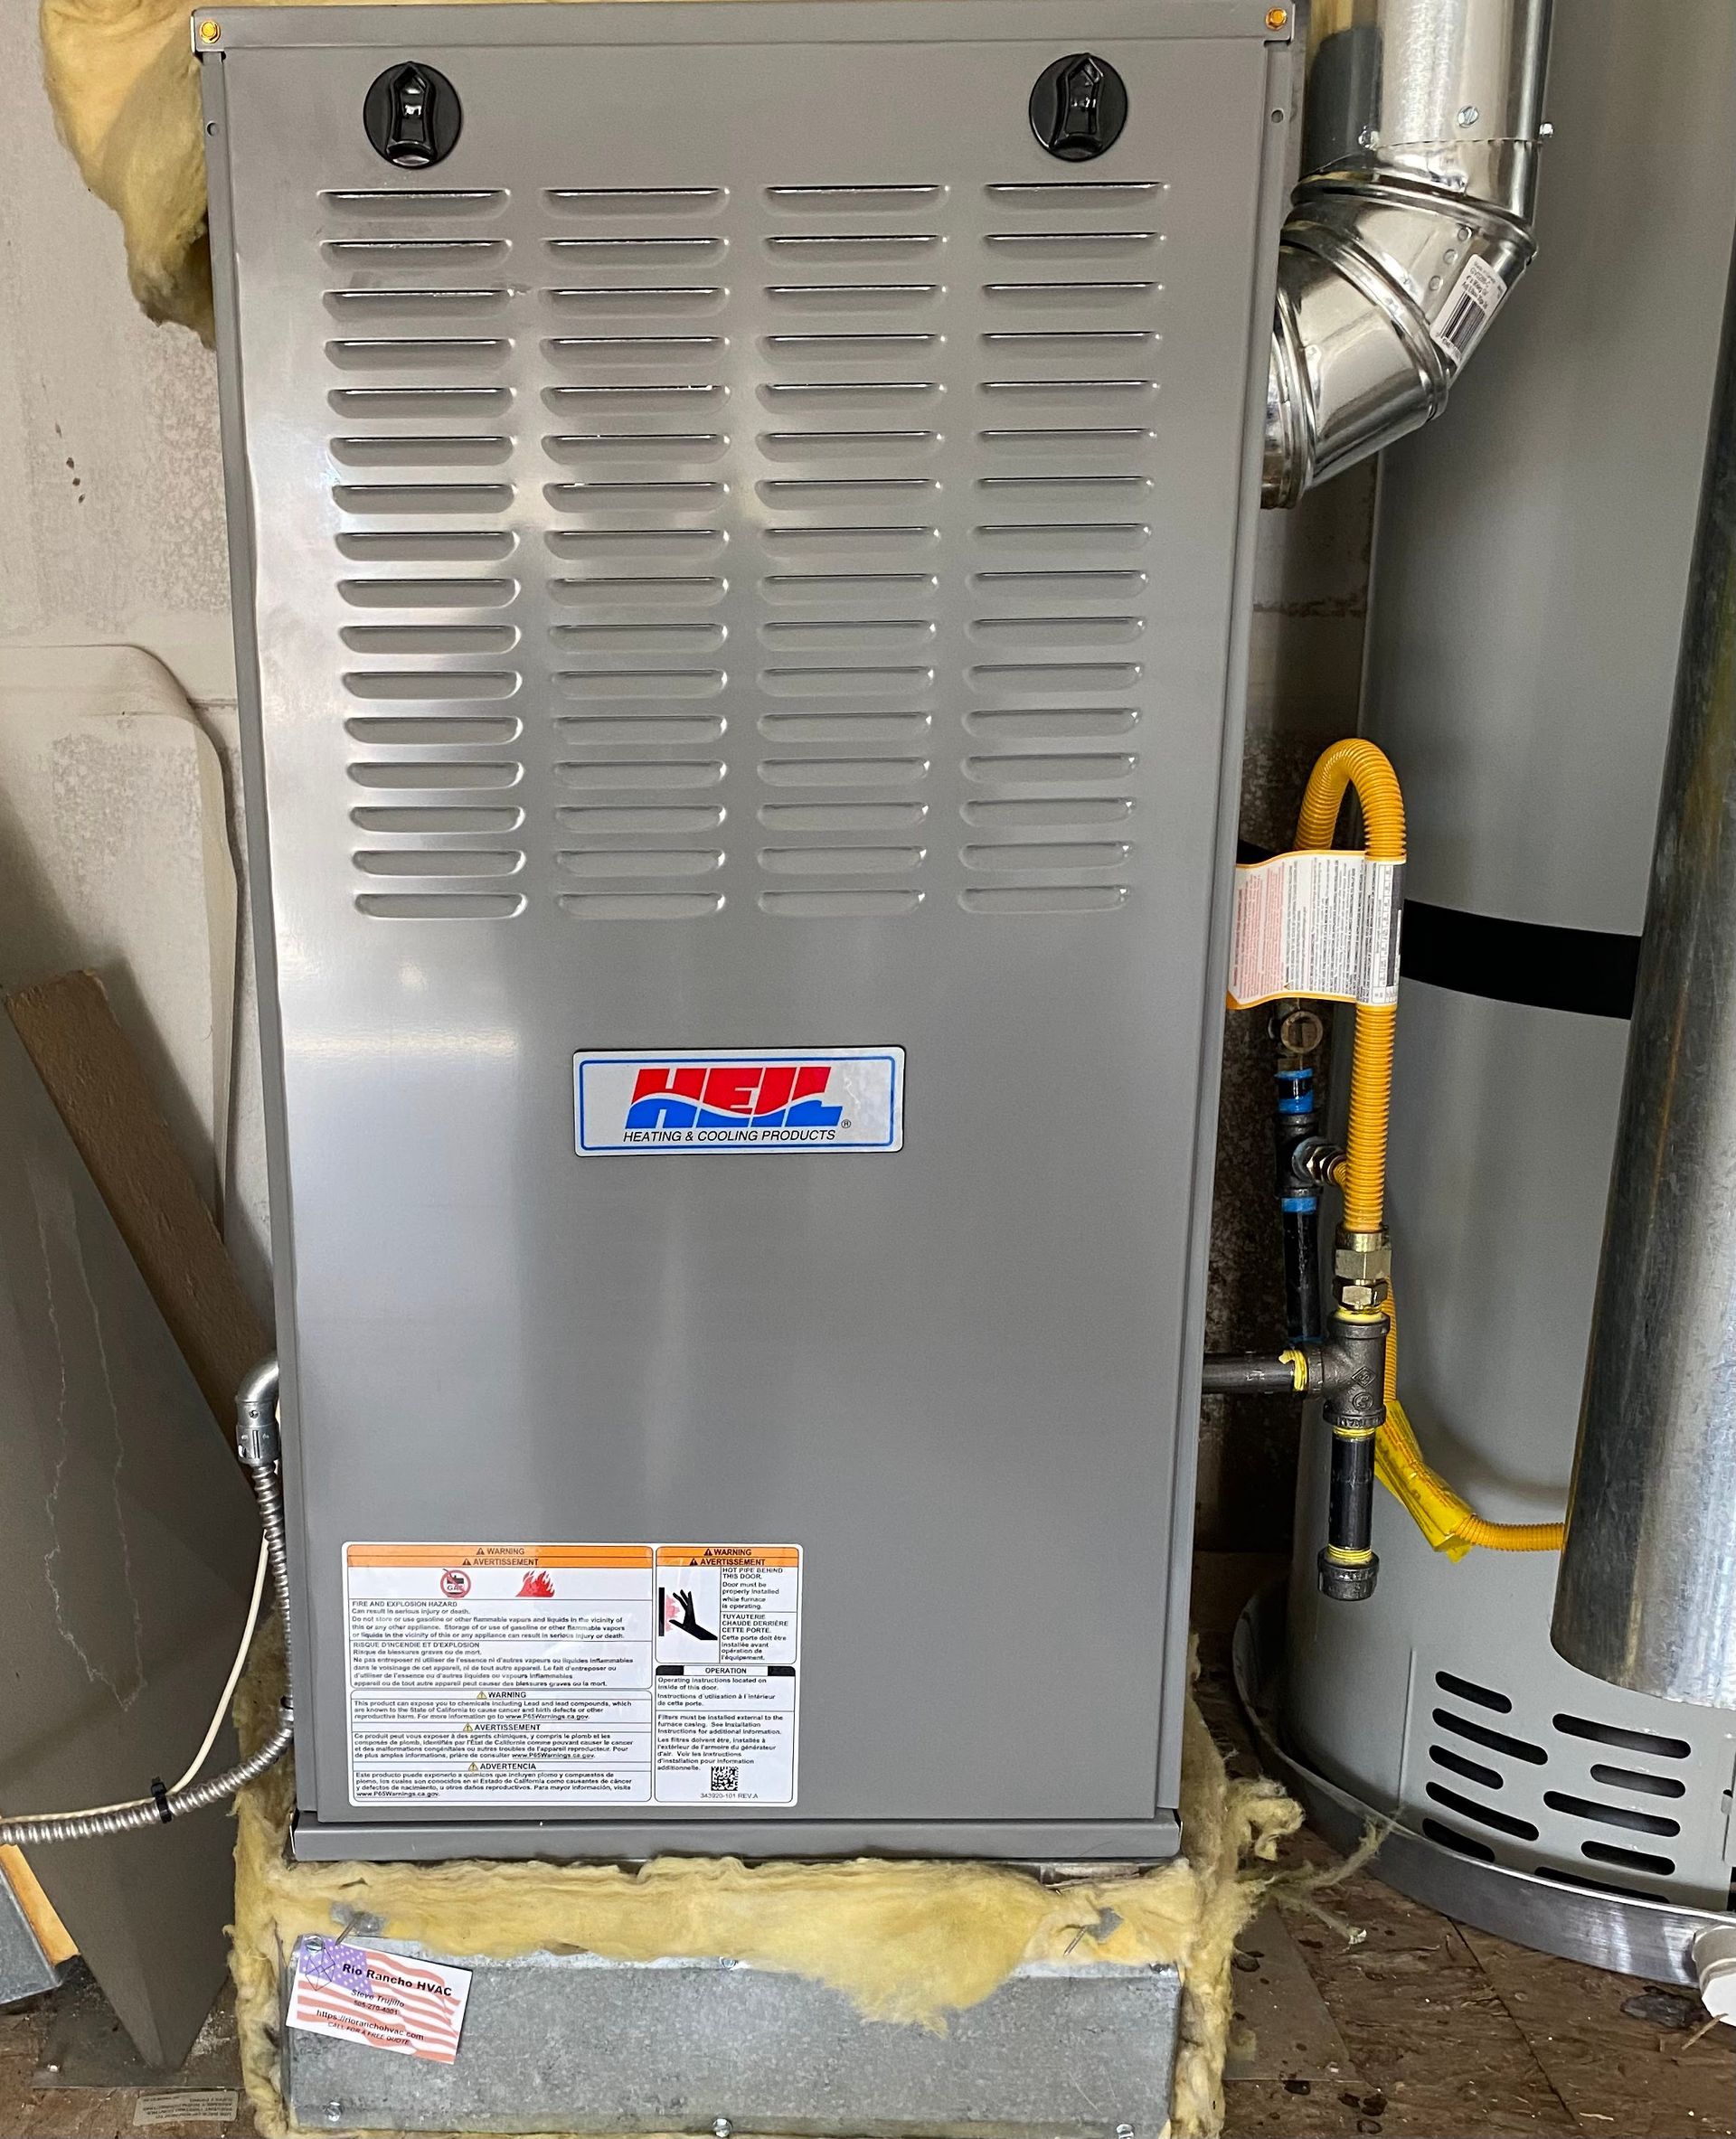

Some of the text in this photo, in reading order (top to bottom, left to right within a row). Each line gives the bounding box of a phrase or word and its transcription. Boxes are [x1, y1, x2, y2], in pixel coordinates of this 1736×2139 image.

[625, 1066, 843, 1129] HEIL
[623, 1129, 836, 1142] HEATING & COOLING PRODUCTS
[342, 1964, 452, 1996] Rio Rancho HVAC
[351, 1989, 405, 2008] Steve Trujillo
[386, 2035, 410, 2045] QUOTE
